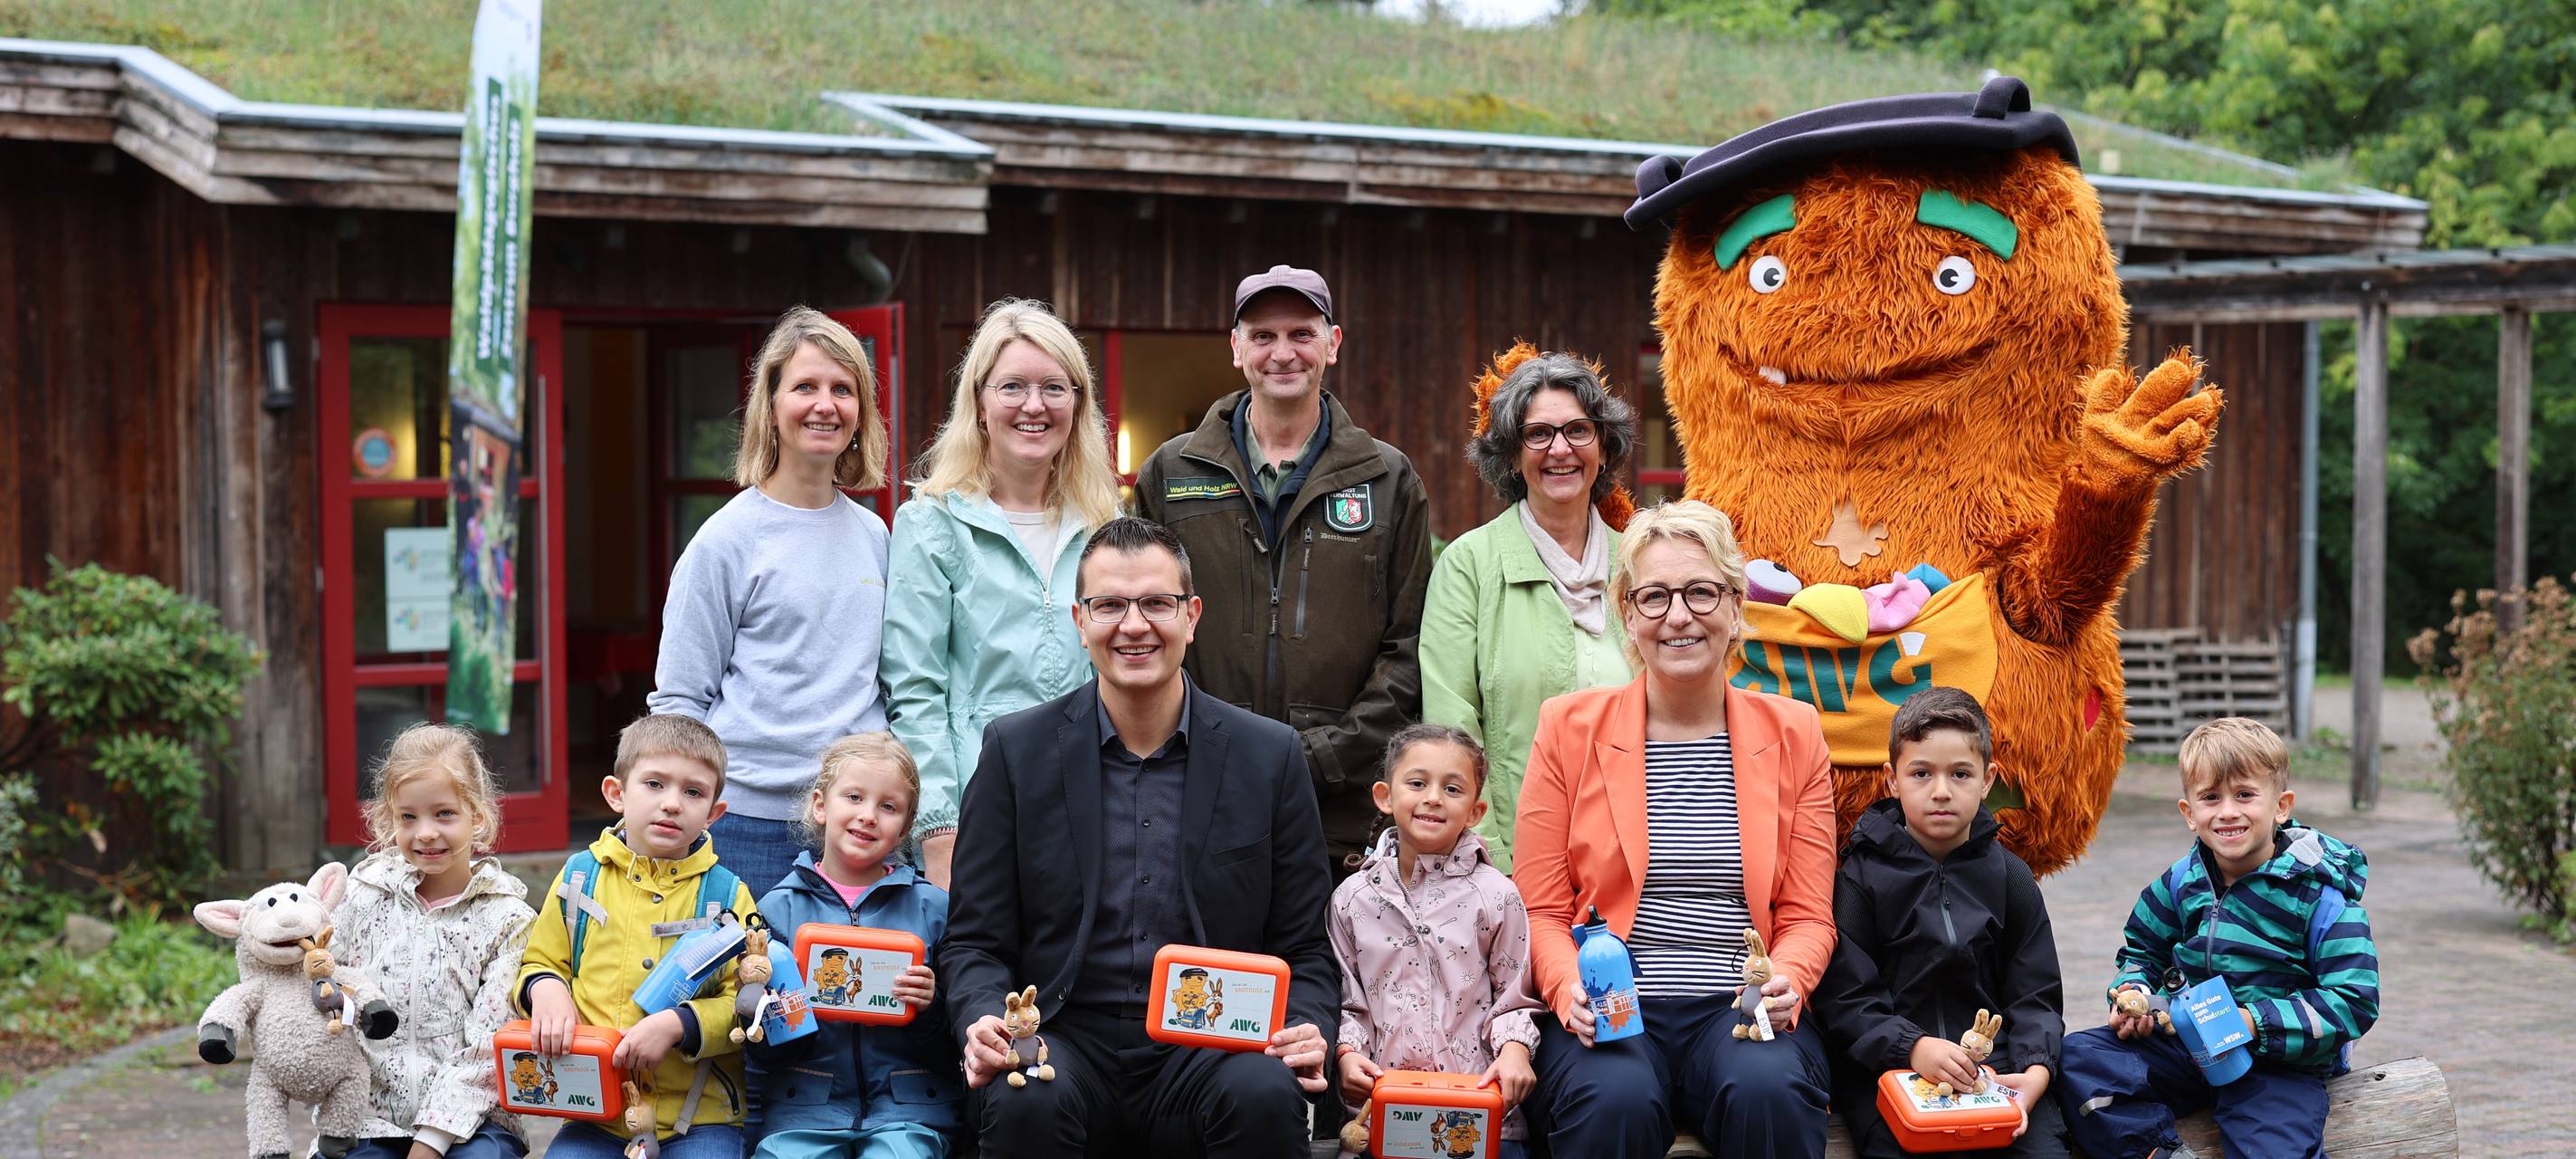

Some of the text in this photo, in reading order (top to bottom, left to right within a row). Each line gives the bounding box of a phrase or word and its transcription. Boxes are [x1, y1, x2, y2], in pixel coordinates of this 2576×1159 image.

[477, 93, 501, 359] Waldpädagogisches
[501, 241, 517, 358] Zentrum
[1730, 632, 1932, 713] AWG
[868, 995, 898, 1008] AWG
[2190, 995, 2221, 1012] Alles Gute
[1229, 1019, 1261, 1033] AWG
[1997, 1086, 2018, 1098] ESW
[568, 1094, 596, 1106] AWG
[1973, 1096, 2000, 1105] AWG
[1393, 1110, 1424, 1122] AWG
